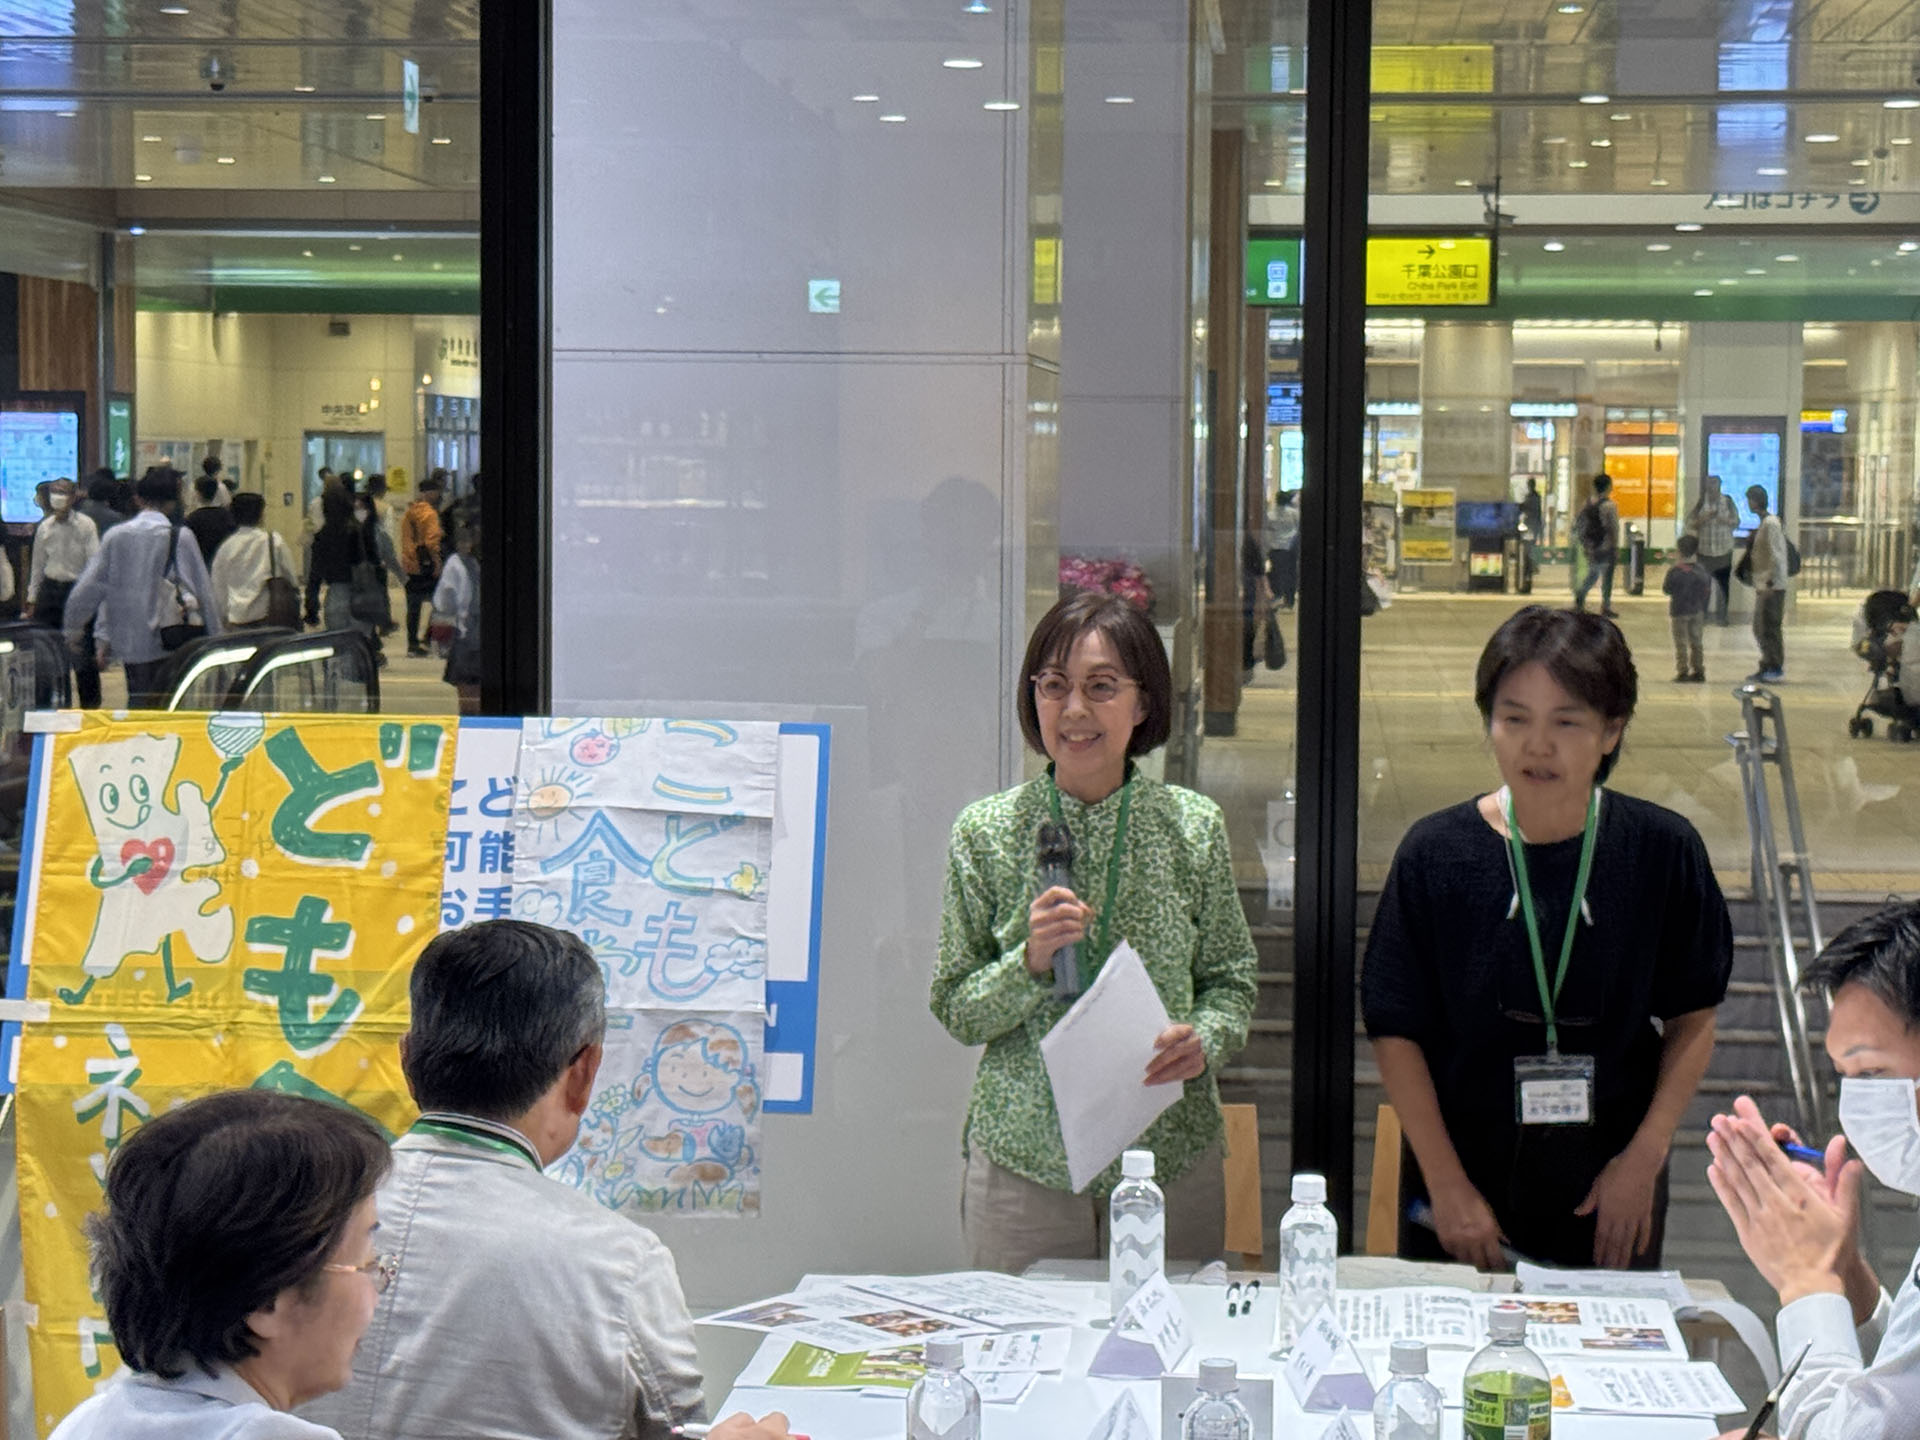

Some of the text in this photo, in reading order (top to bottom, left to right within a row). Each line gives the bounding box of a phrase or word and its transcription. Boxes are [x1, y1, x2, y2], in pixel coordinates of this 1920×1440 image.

[1401, 263, 1479, 279] 千葉公園口
